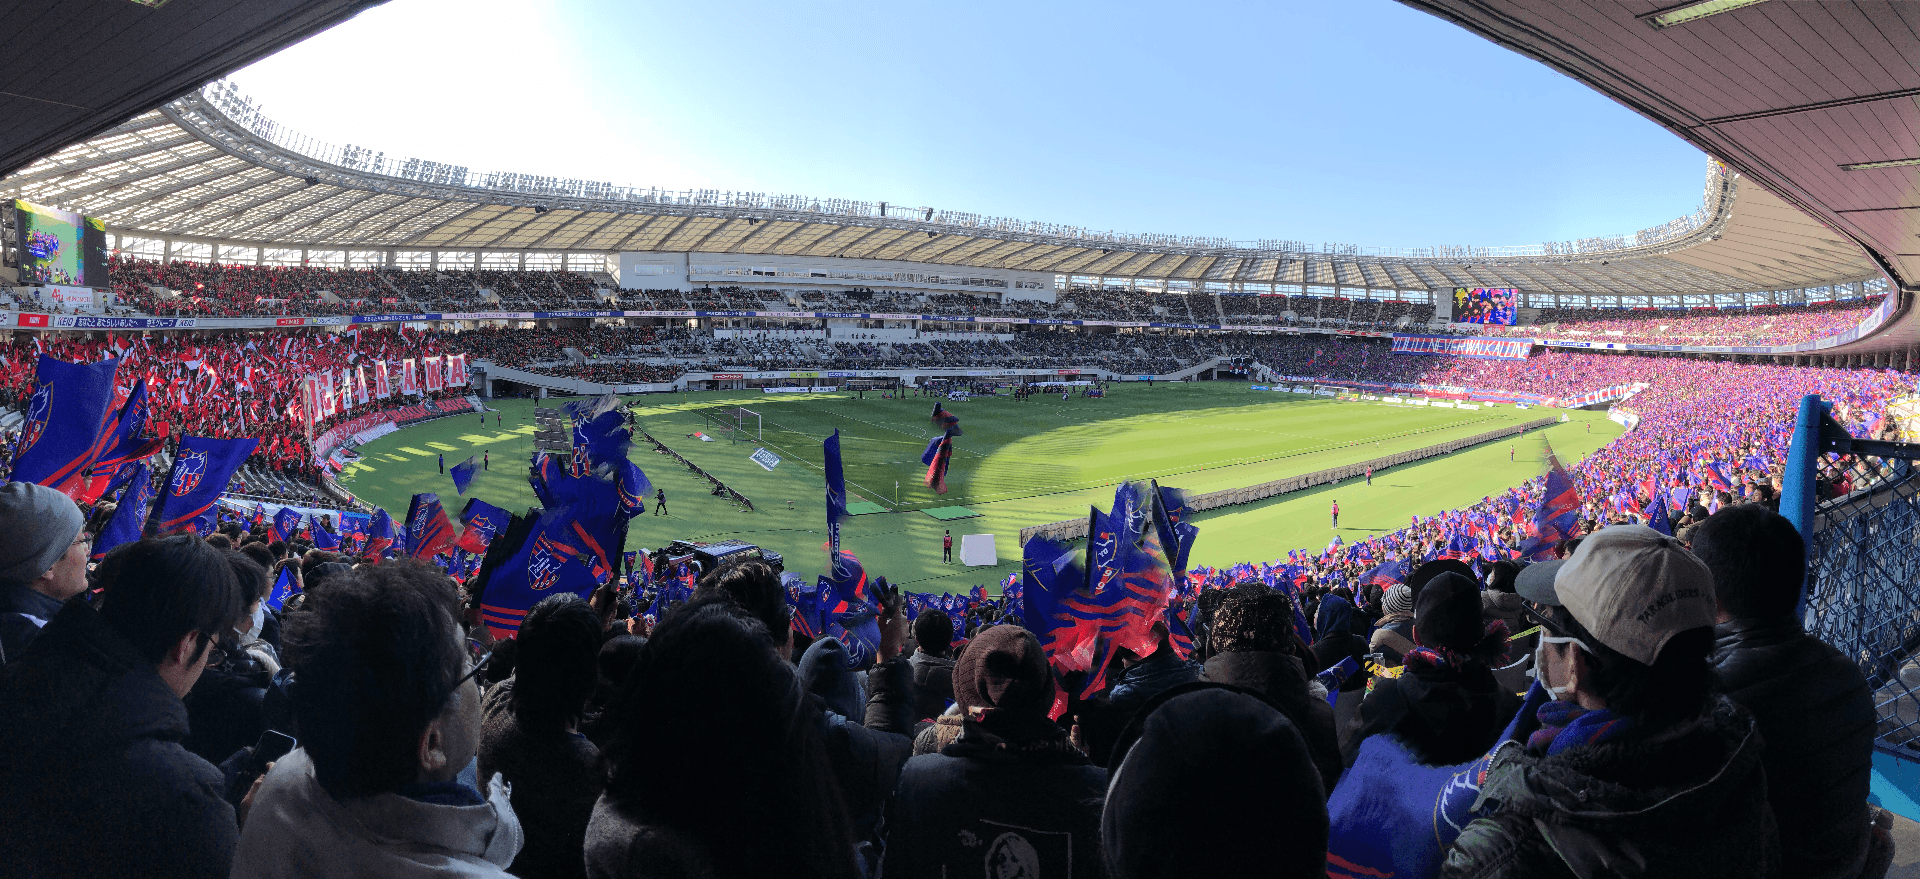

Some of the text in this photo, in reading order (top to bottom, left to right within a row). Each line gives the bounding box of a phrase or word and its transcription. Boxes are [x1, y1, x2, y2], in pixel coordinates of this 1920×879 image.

[58, 316, 74, 327] KEIO
[178, 319, 194, 327] KEIO
[1426, 337, 1466, 355] NEVER
[1465, 339, 1496, 356] WALK
[1492, 340, 1532, 359] ALONE
